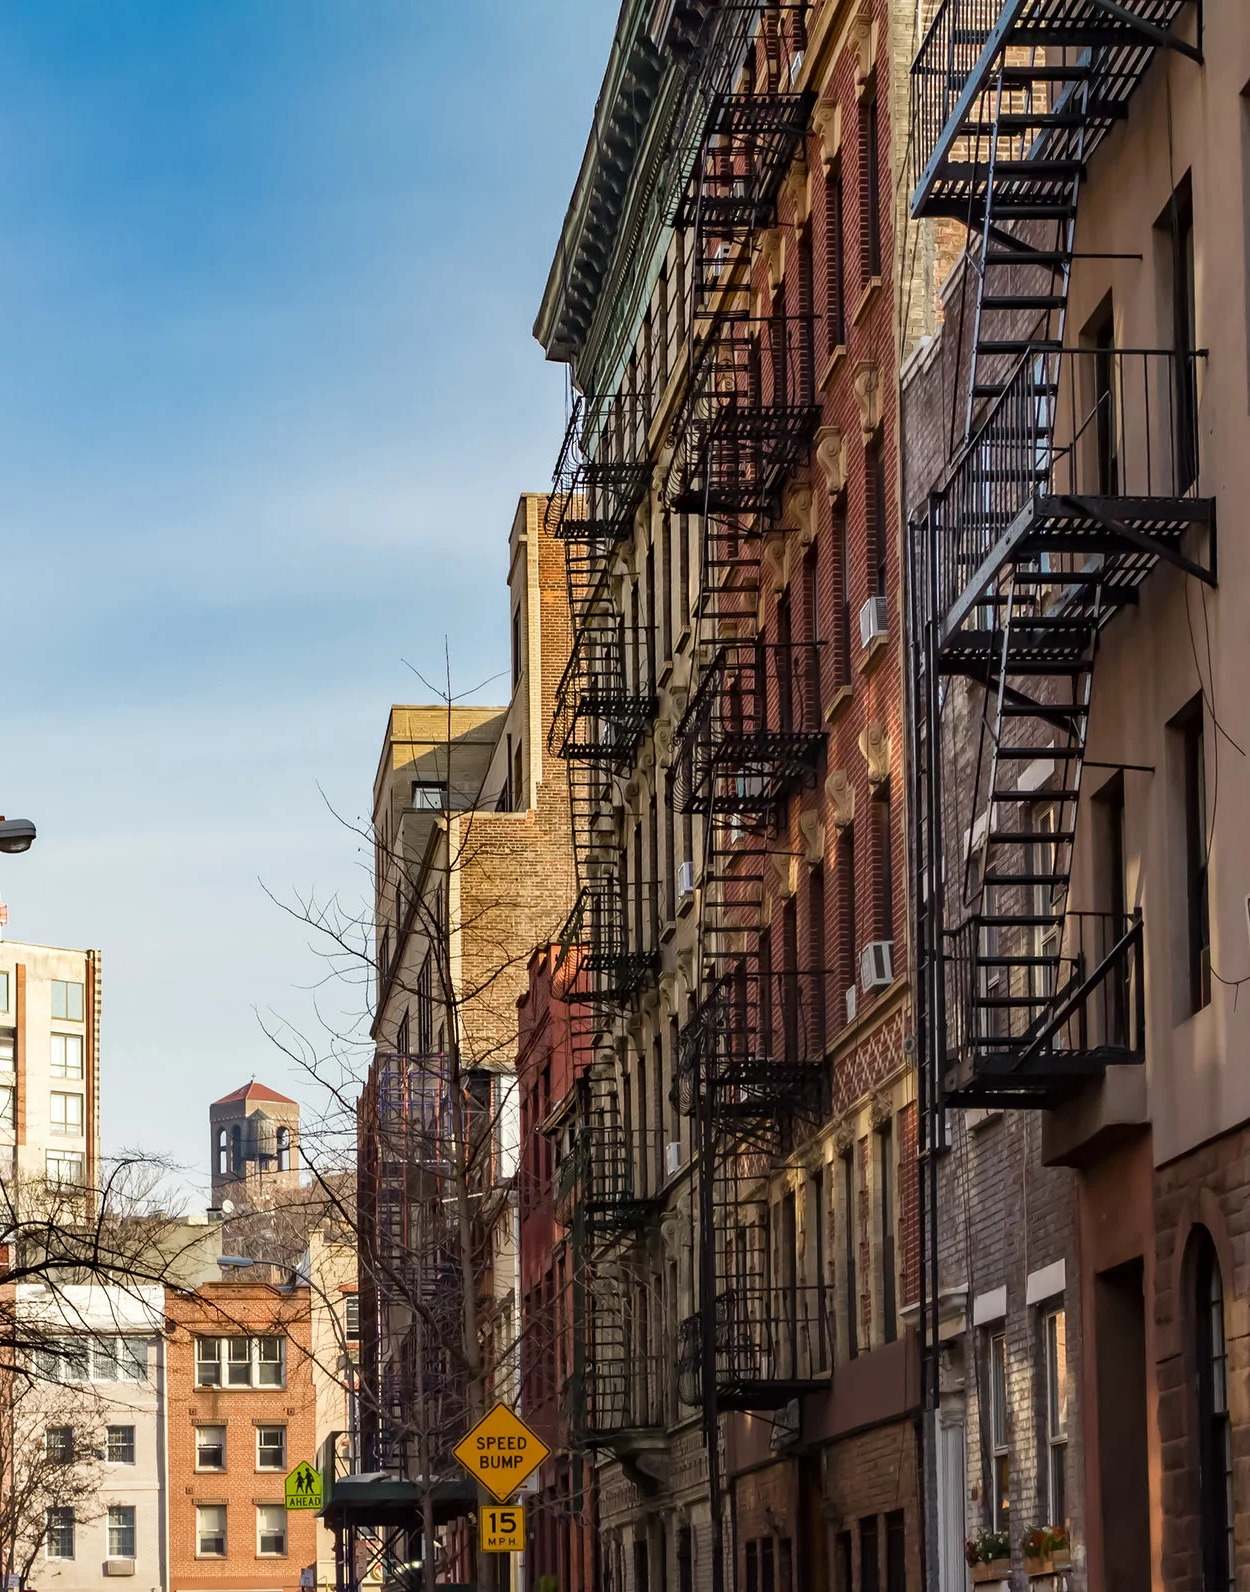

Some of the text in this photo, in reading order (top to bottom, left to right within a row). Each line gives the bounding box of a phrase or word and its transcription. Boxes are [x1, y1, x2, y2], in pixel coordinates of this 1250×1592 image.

[476, 1436, 527, 1450] SPEED
[479, 1455, 524, 1469] BUMP
[290, 1497, 321, 1506] AHEAD
[489, 1512, 517, 1533] 15
